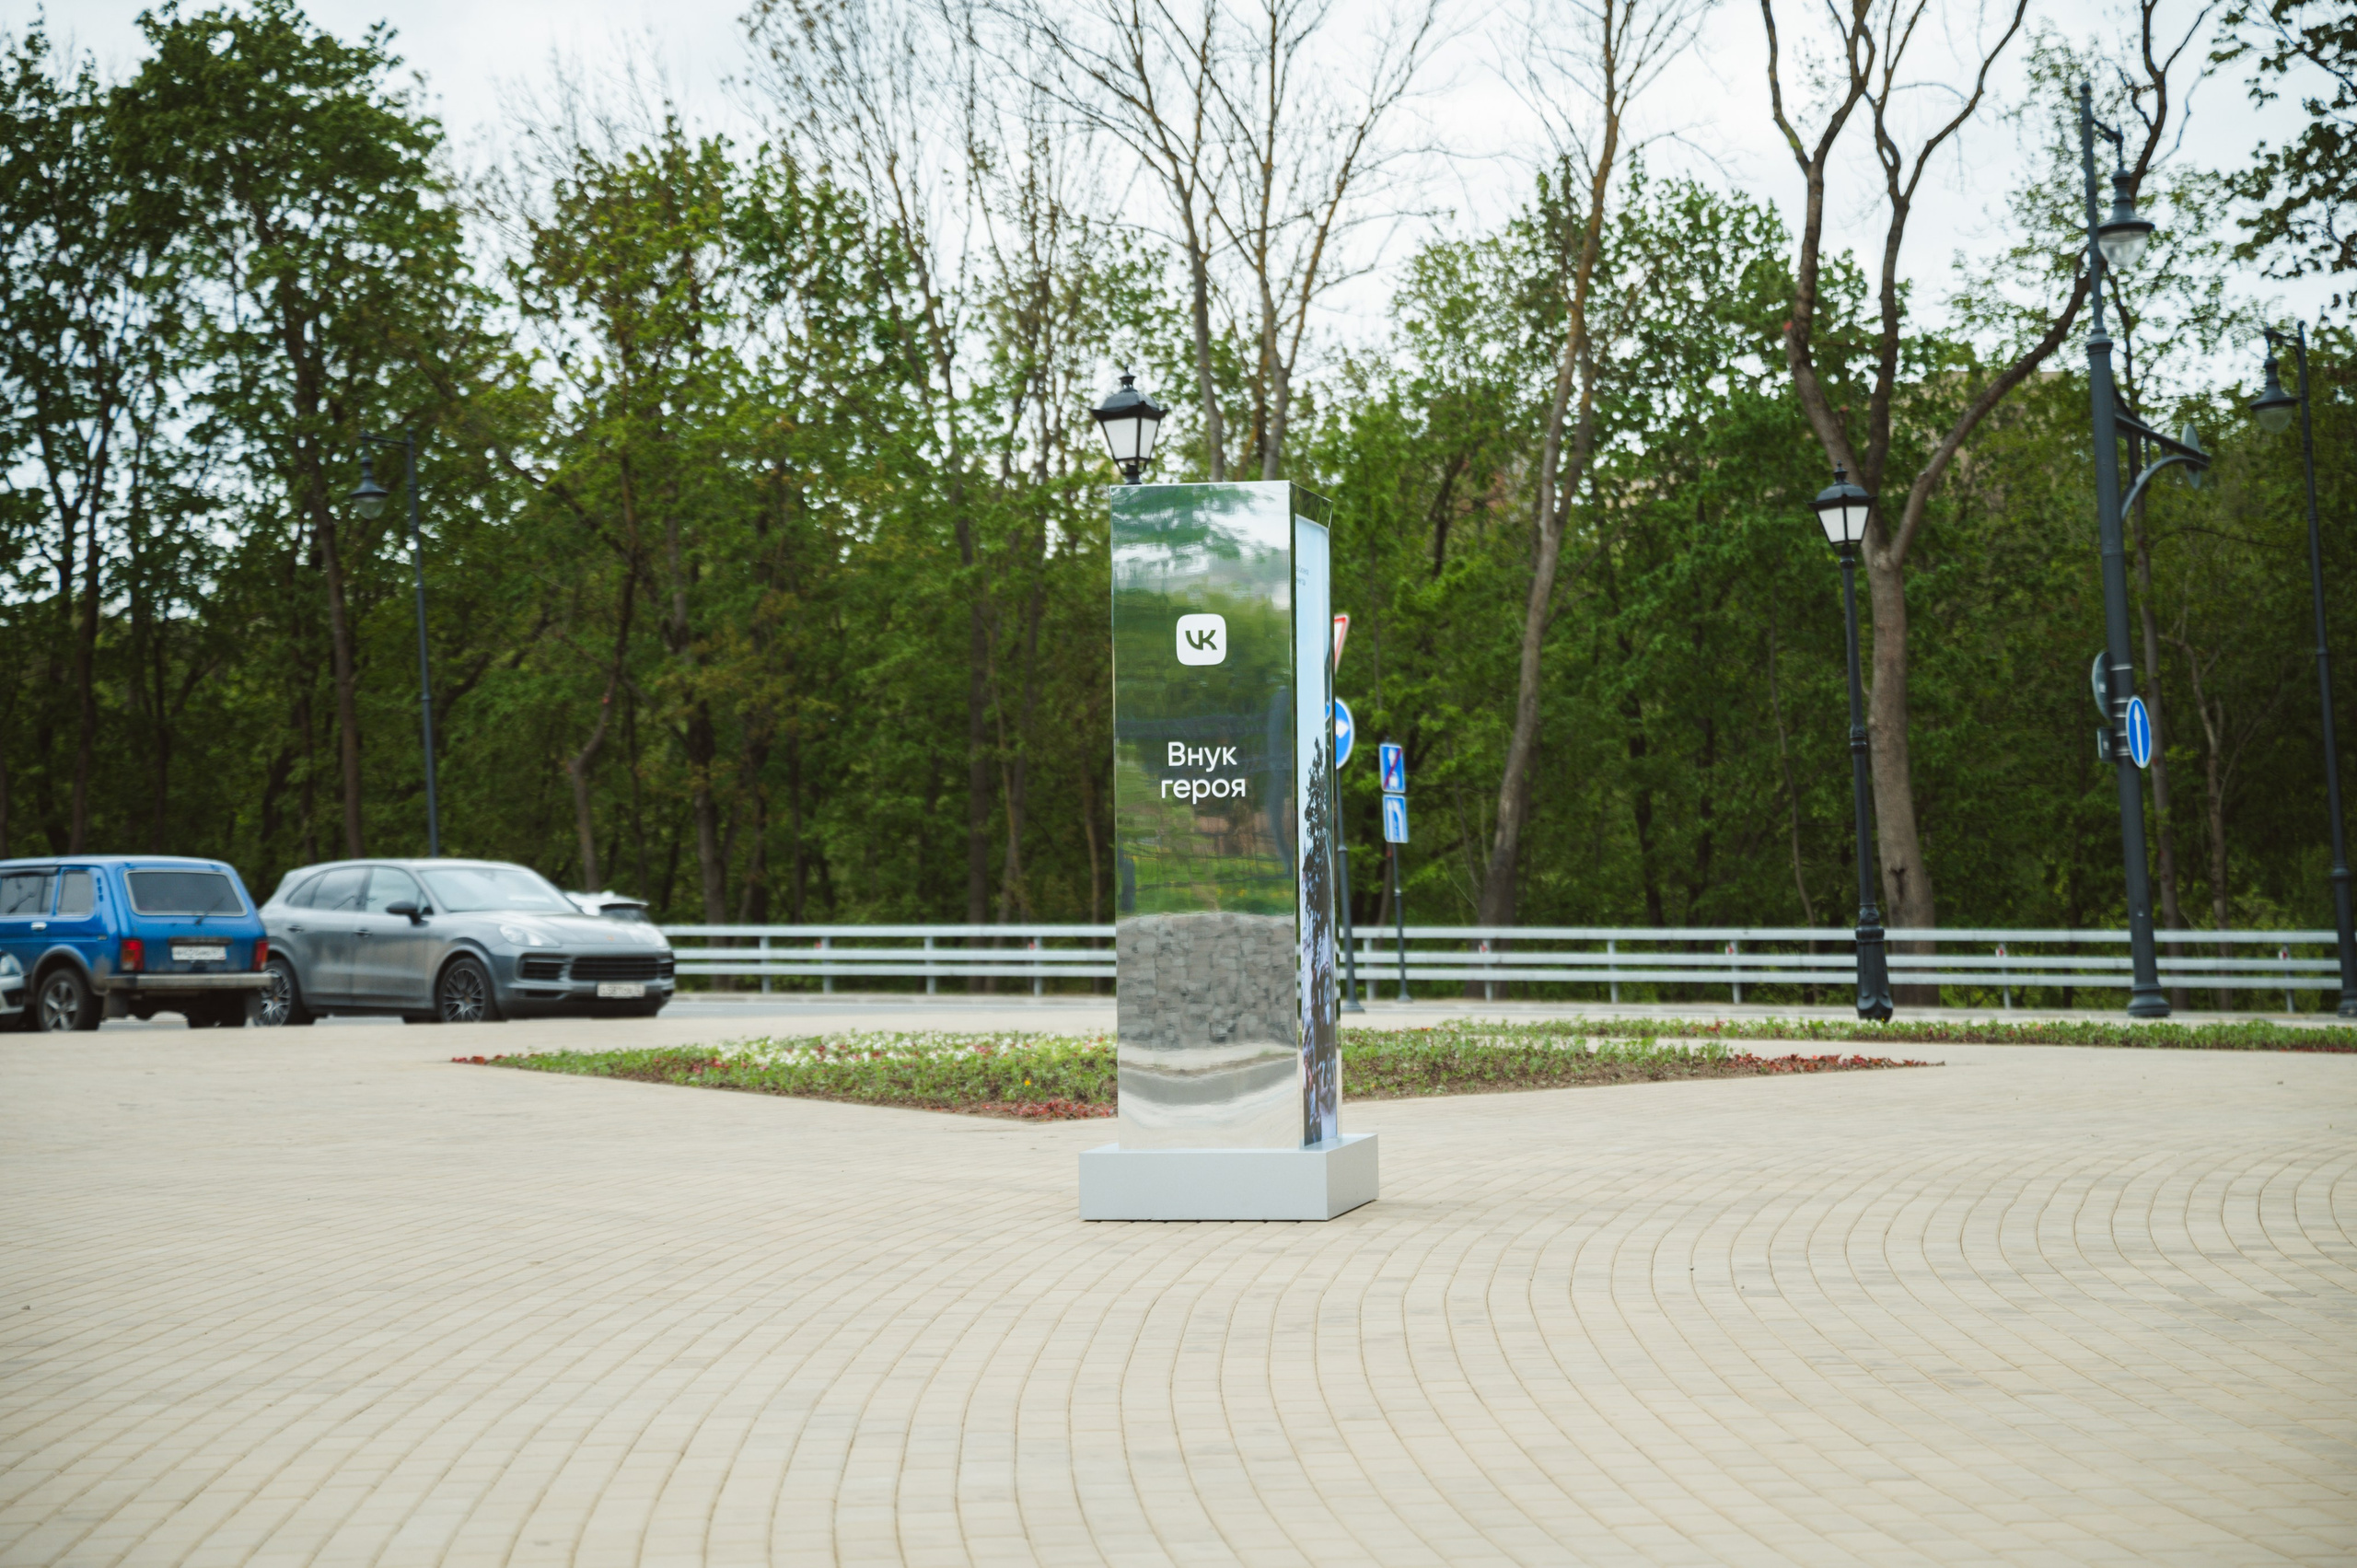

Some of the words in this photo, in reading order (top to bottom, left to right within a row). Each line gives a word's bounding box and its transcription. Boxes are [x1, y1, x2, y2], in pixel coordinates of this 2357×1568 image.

[1185, 629, 1217, 651] VK
[1167, 741, 1237, 772] Внук
[1161, 778, 1246, 805] героя
